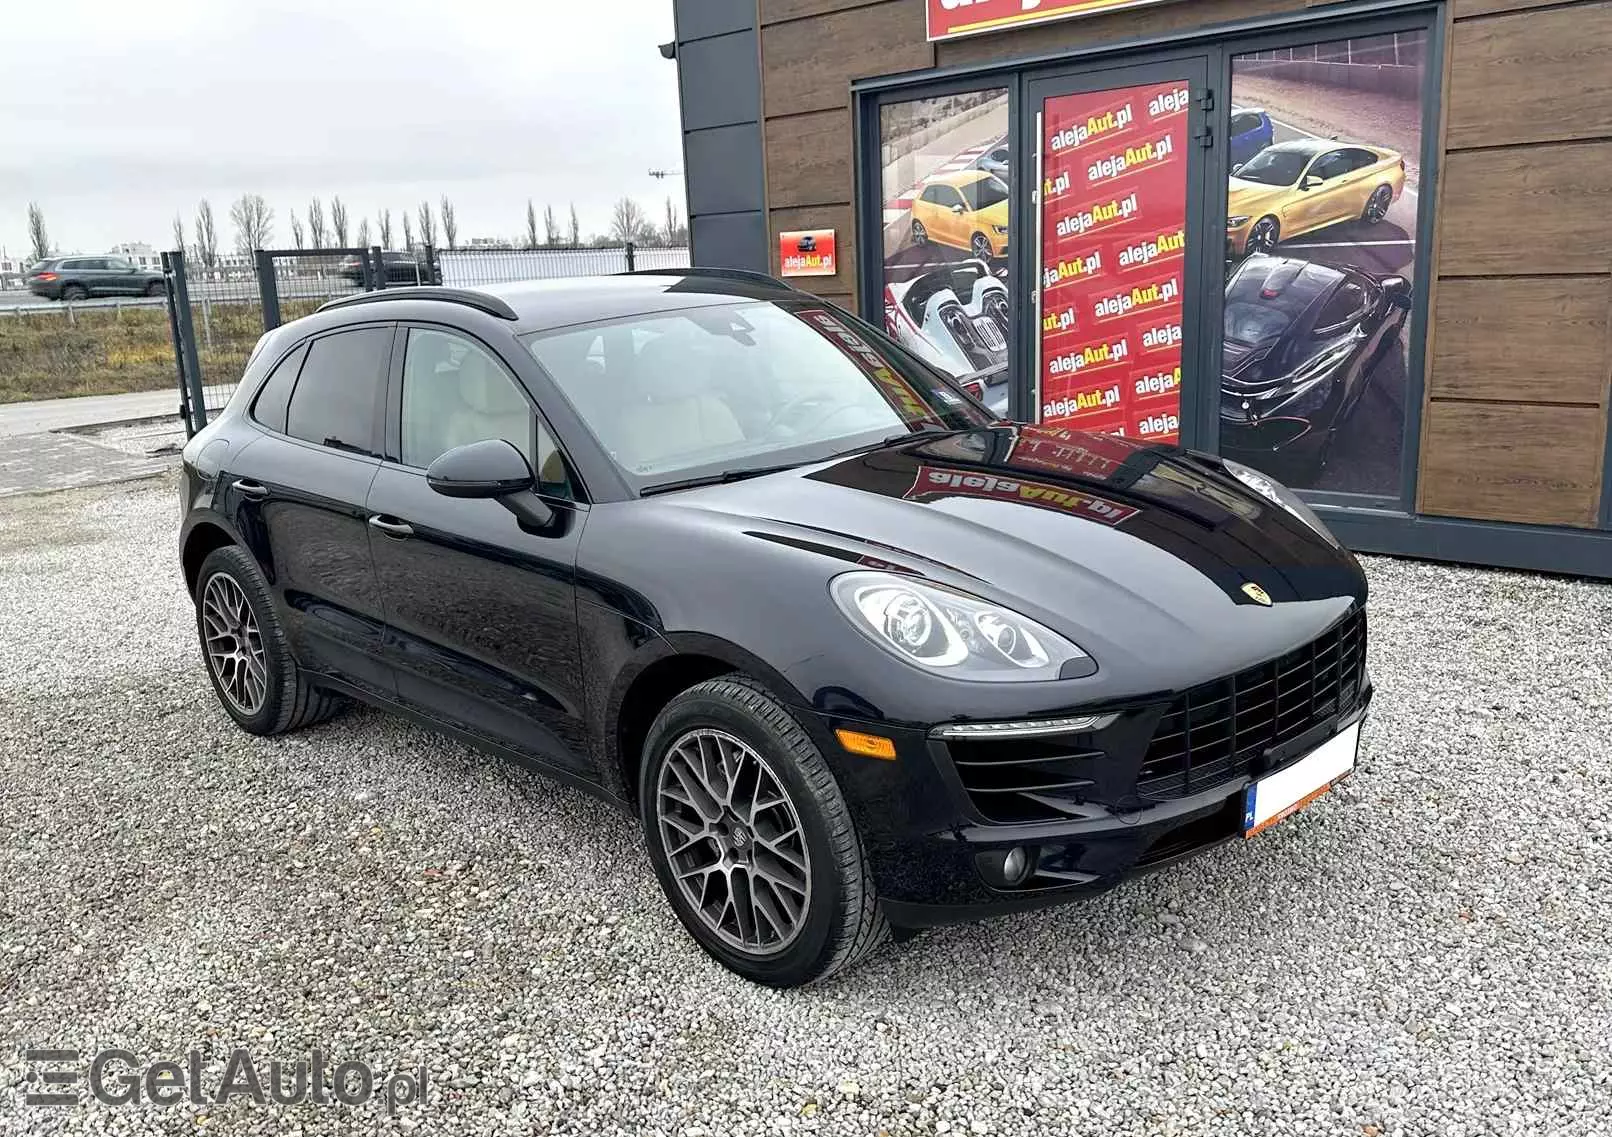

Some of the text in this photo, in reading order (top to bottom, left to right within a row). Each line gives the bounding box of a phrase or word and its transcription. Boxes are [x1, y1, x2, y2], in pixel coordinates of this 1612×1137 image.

[1051, 103, 1133, 150] alejaAut.pl
[1088, 134, 1173, 181] alejaAut.pl
[1056, 193, 1138, 237] alejaAut.pl
[784, 254, 833, 270] alejaAut.pl
[1094, 278, 1179, 317] alejaAut.pl
[1049, 339, 1128, 374] alejaAut.pl
[1043, 385, 1121, 418] alejaAut.pl
